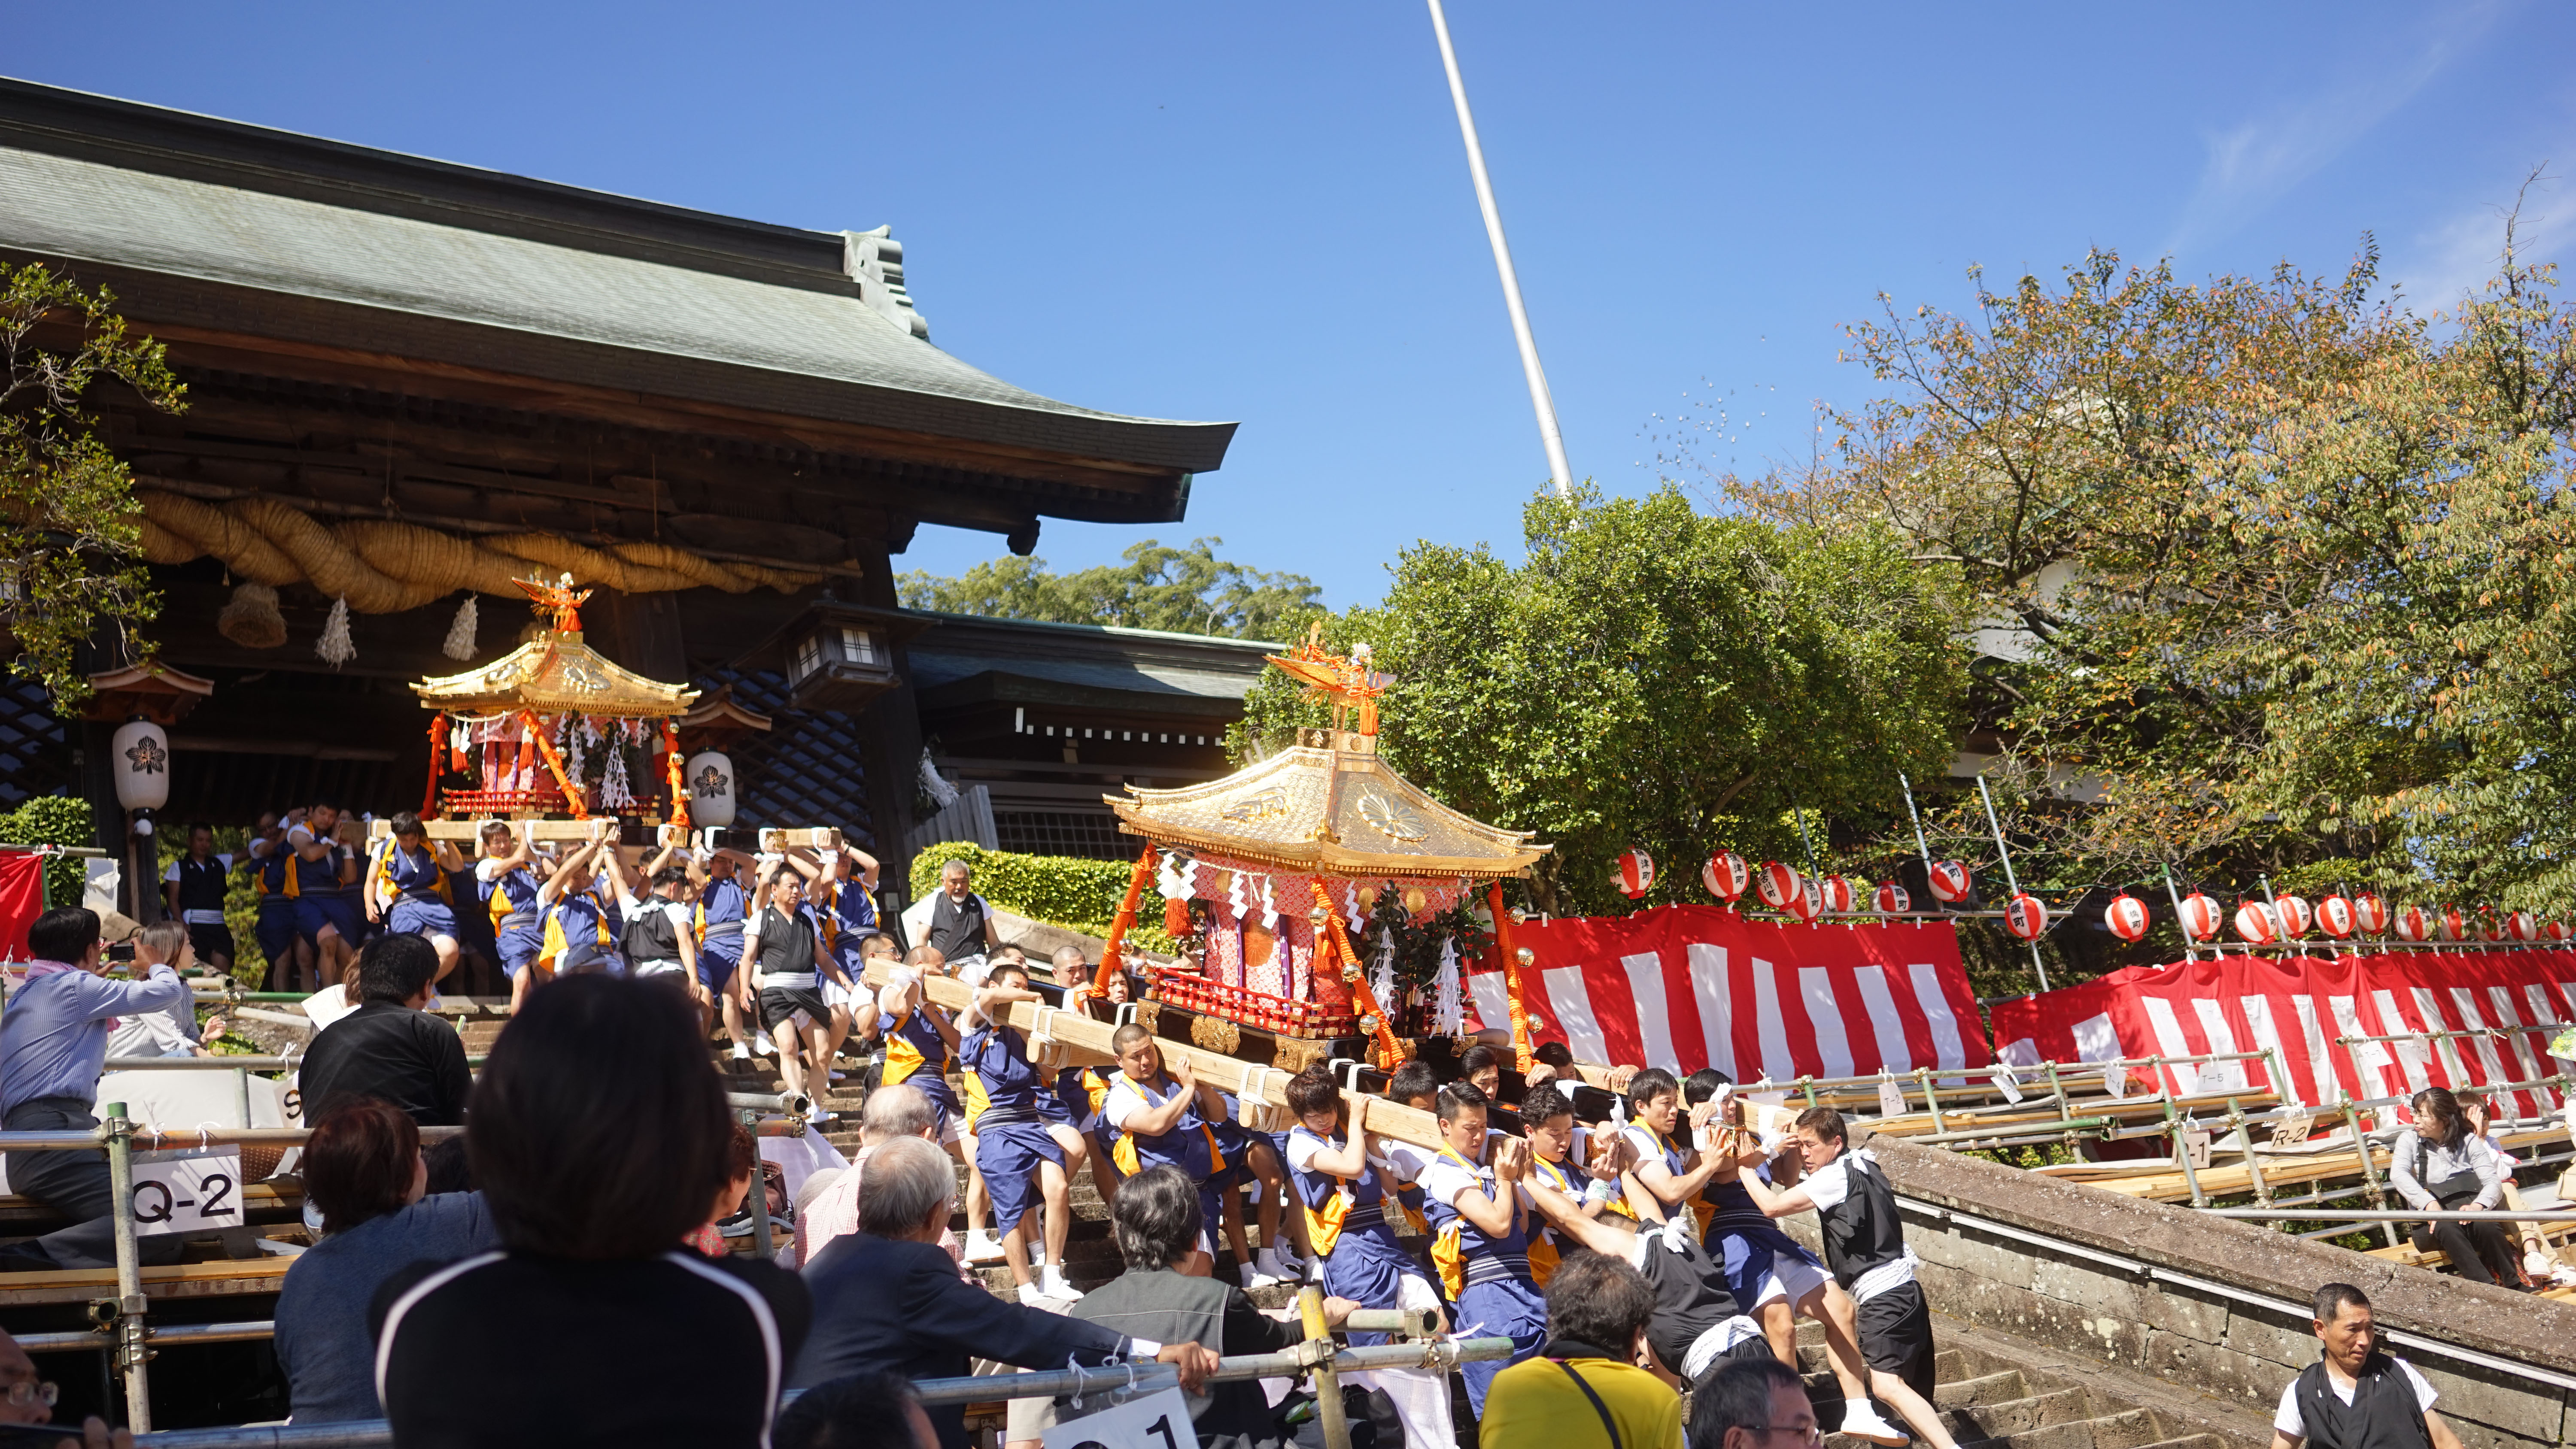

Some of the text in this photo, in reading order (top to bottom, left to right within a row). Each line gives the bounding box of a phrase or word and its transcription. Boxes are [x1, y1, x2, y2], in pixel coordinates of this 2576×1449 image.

[2126, 901, 2142, 928] 新橋町
[2202, 1073, 2224, 1084] T-5
[1884, 1094, 1901, 1108] T-2
[2272, 1126, 2307, 1147] R-2
[133, 1173, 235, 1223] Q-2
